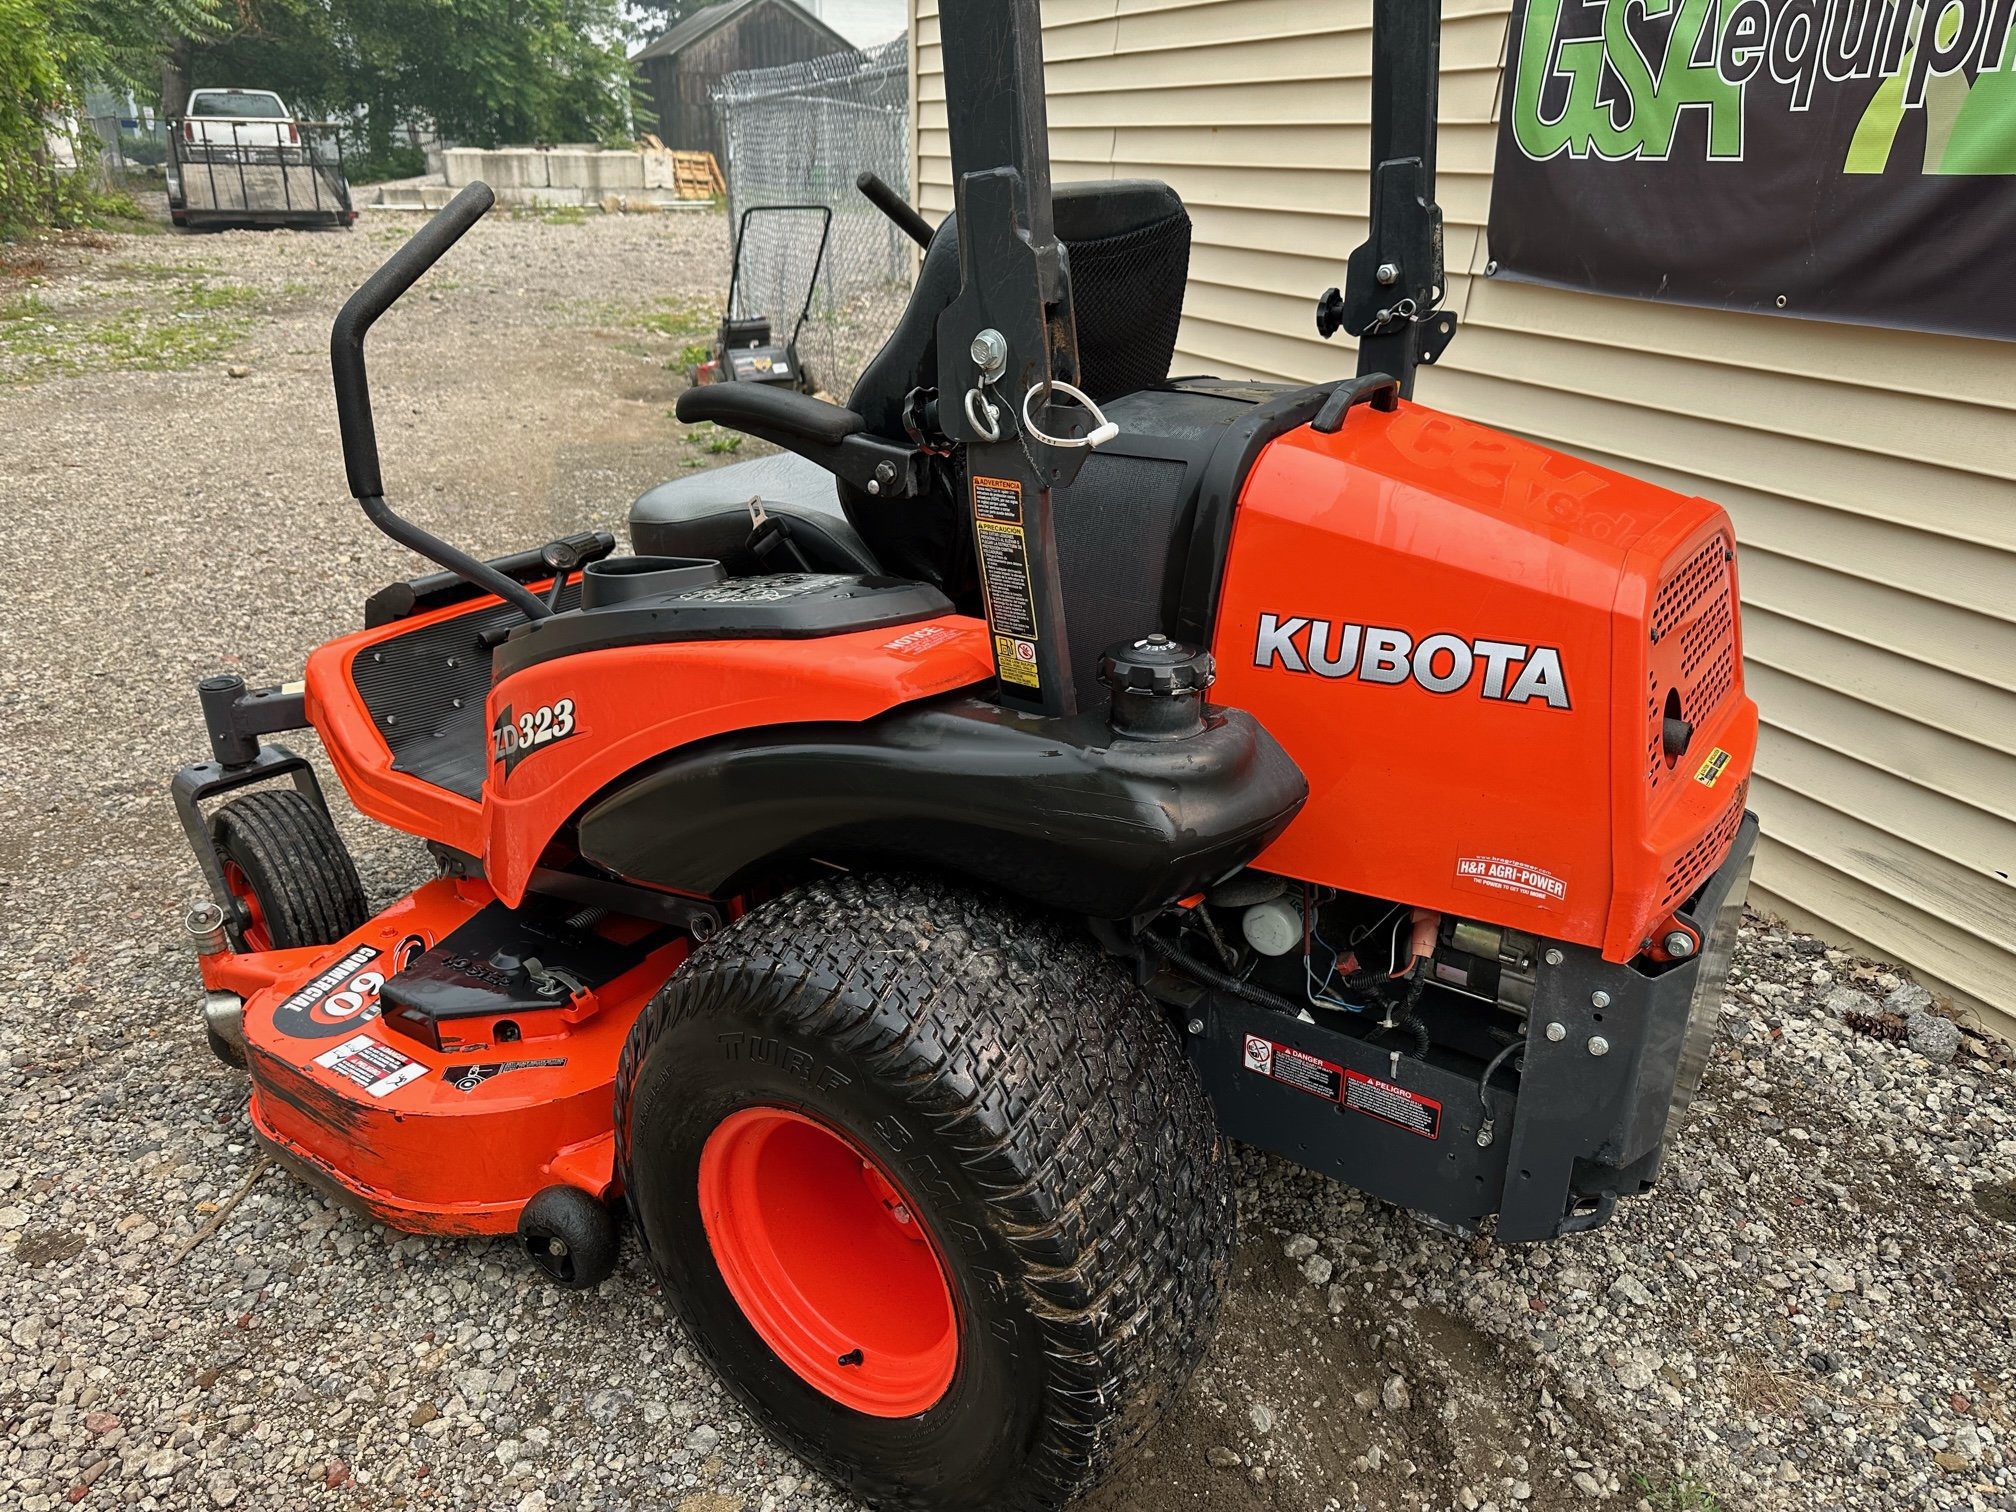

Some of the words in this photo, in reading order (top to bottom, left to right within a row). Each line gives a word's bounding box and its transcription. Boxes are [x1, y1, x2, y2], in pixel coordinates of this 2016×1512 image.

[980, 478, 1020, 490] ADVERTENCIA
[983, 523, 1021, 535] PRECAUCIÓN
[883, 626, 944, 649] NOTICE
[1254, 613, 1572, 710] KUBOTA
[493, 699, 574, 760] ZD323
[1460, 861, 1486, 875] H&R
[1488, 864, 1563, 896] AGRI-POWER
[1482, 879, 1502, 889] POWER
[283, 946, 377, 1012] COMMERCIAL
[717, 1031, 852, 1093] TURF
[1292, 1050, 1323, 1067] DANGER
[1375, 1080, 1412, 1099] PELIGRO
